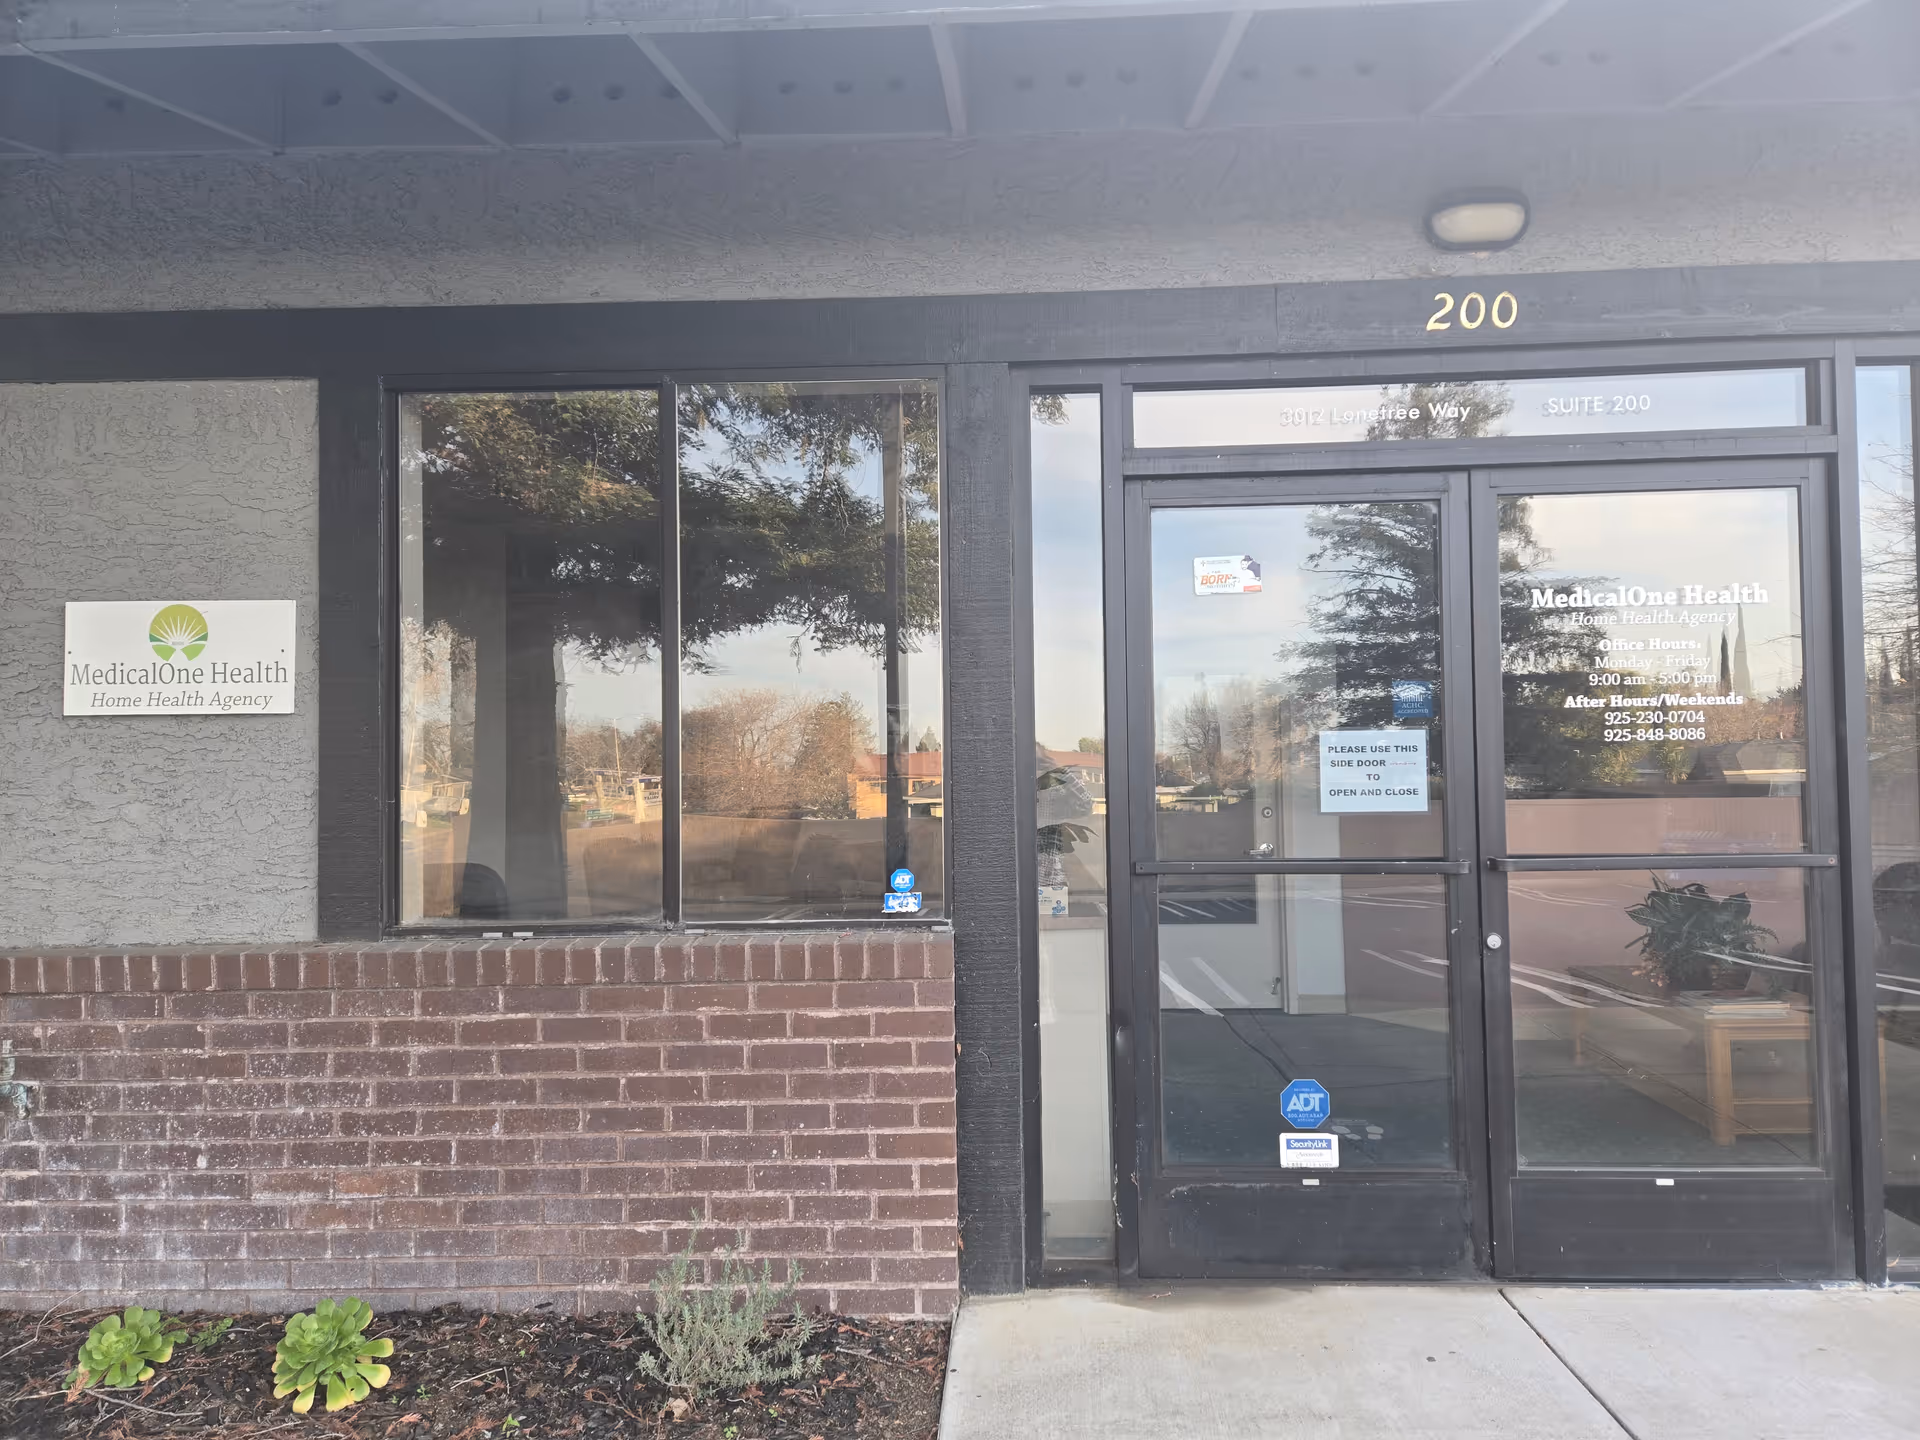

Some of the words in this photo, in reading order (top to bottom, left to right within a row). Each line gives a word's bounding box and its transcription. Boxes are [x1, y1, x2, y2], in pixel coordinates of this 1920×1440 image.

[1426, 291, 1518, 331] 200
[1548, 396, 1604, 413] SUITE
[1612, 395, 1651, 411] 200
[1282, 407, 1327, 423] 3012
[1333, 405, 1421, 422] Lonetree
[1428, 402, 1471, 421] Way
[1531, 585, 1677, 608] MedicalOne
[1683, 582, 1769, 605] Health
[1570, 611, 1618, 626] Home
[1622, 610, 1674, 625] Health
[1679, 610, 1736, 627] Agency
[1600, 638, 1645, 651] Office
[1594, 655, 1652, 670] Monday
[1665, 653, 1711, 669] Friday
[70, 662, 204, 686] MedicalOne
[211, 661, 289, 684] Health
[1589, 673, 1621, 686] 9:00
[1624, 675, 1647, 685] am
[1659, 671, 1690, 684] 5:00
[1694, 674, 1717, 687] pm
[90, 692, 142, 708] Home
[147, 691, 205, 707] Health
[208, 691, 274, 711] Agency
[1564, 694, 1607, 708] After
[1609, 693, 1743, 708] Hours/Weekends
[1604, 711, 1706, 726] 925-230-0704
[1604, 728, 1706, 742] 925-848-8086
[1328, 745, 1367, 754] PLEASE
[1370, 745, 1391, 753] USE
[1394, 745, 1418, 753] THIS
[1330, 760, 1354, 768] SIDE
[1357, 759, 1386, 767] DOOR
[1366, 773, 1380, 781] TO
[1329, 789, 1357, 797] OPEN
[1360, 788, 1382, 796] AND
[1385, 788, 1419, 796] CLOSE
[894, 875, 912, 884] ADT
[1286, 1093, 1325, 1112] ADT
[1290, 1139, 1328, 1150] SecurityLink
